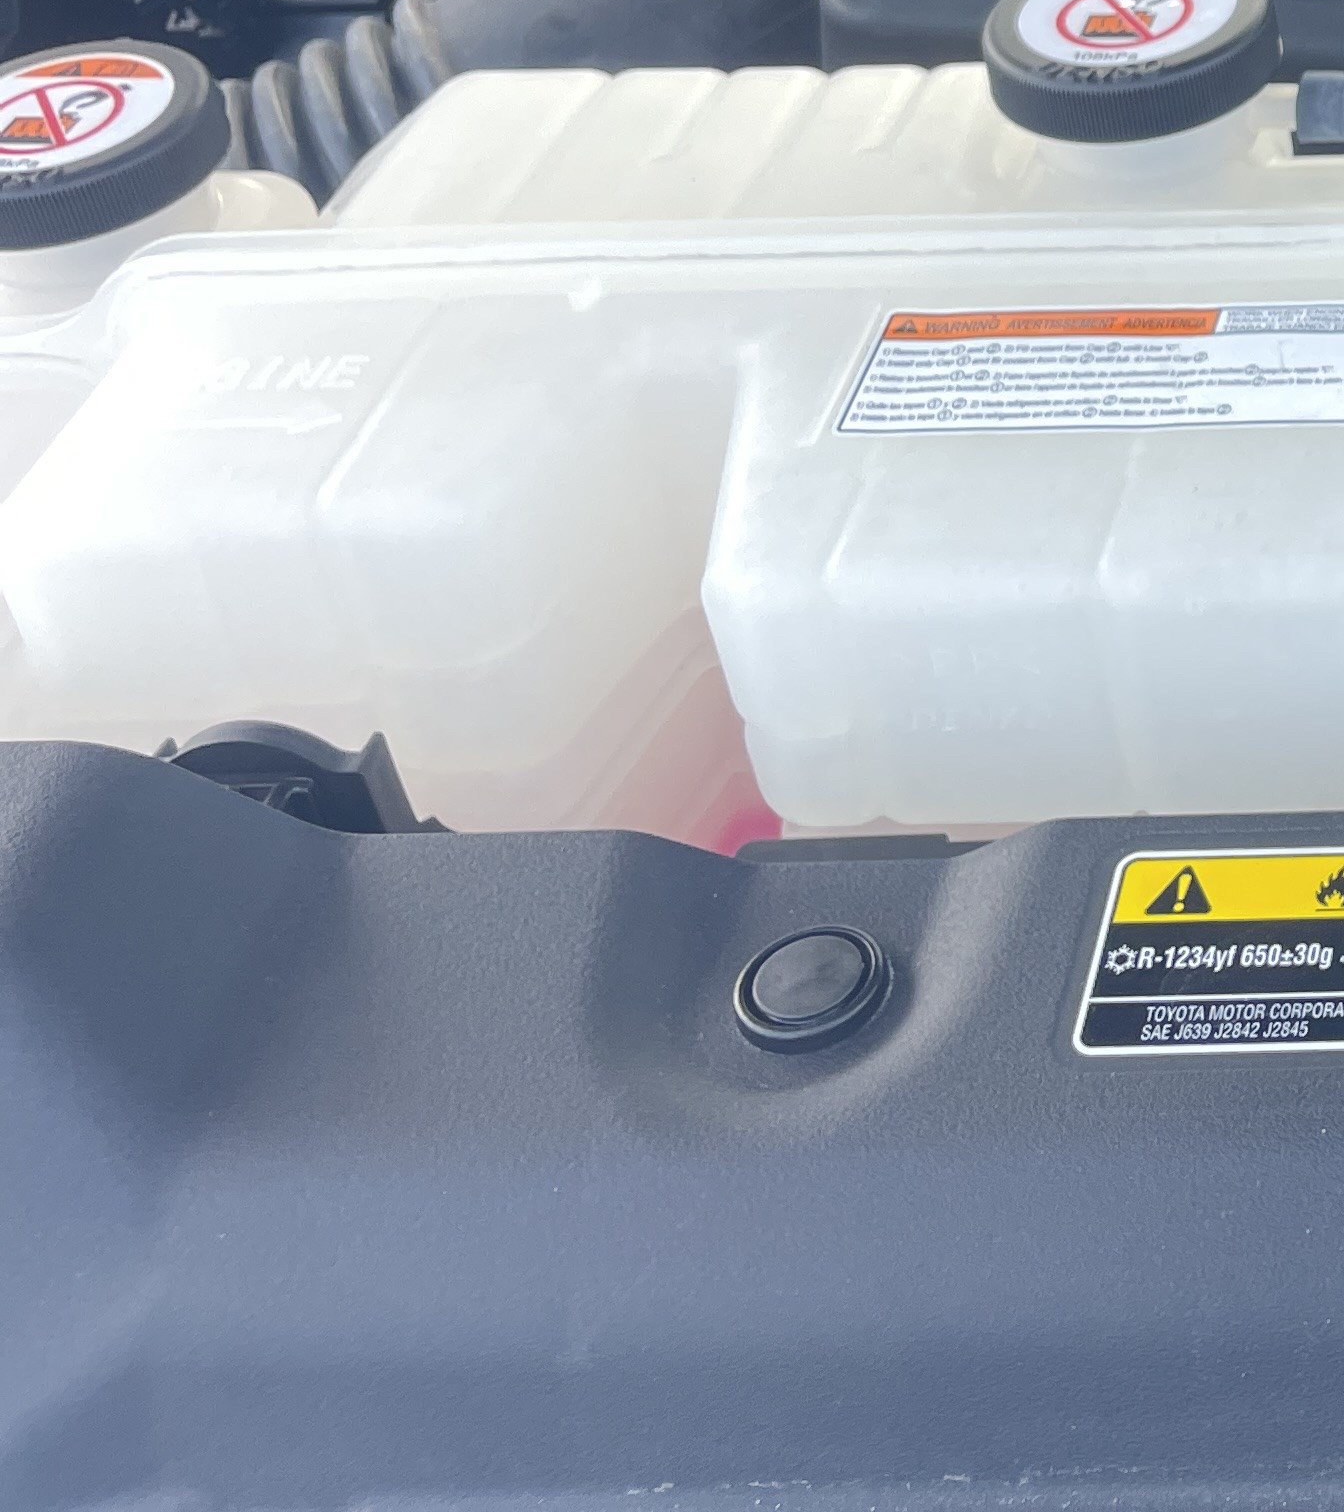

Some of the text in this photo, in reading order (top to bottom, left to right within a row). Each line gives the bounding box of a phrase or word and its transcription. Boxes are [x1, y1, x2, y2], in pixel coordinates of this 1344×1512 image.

[1137, 944, 1238, 973] R-1234yf
[1239, 942, 1334, 971] 650±30g
[1146, 1004, 1206, 1023] TOYOTA
[1208, 1003, 1266, 1021] MOTOR
[1140, 1020, 1310, 1041] SAE J639 J2842 J2845
